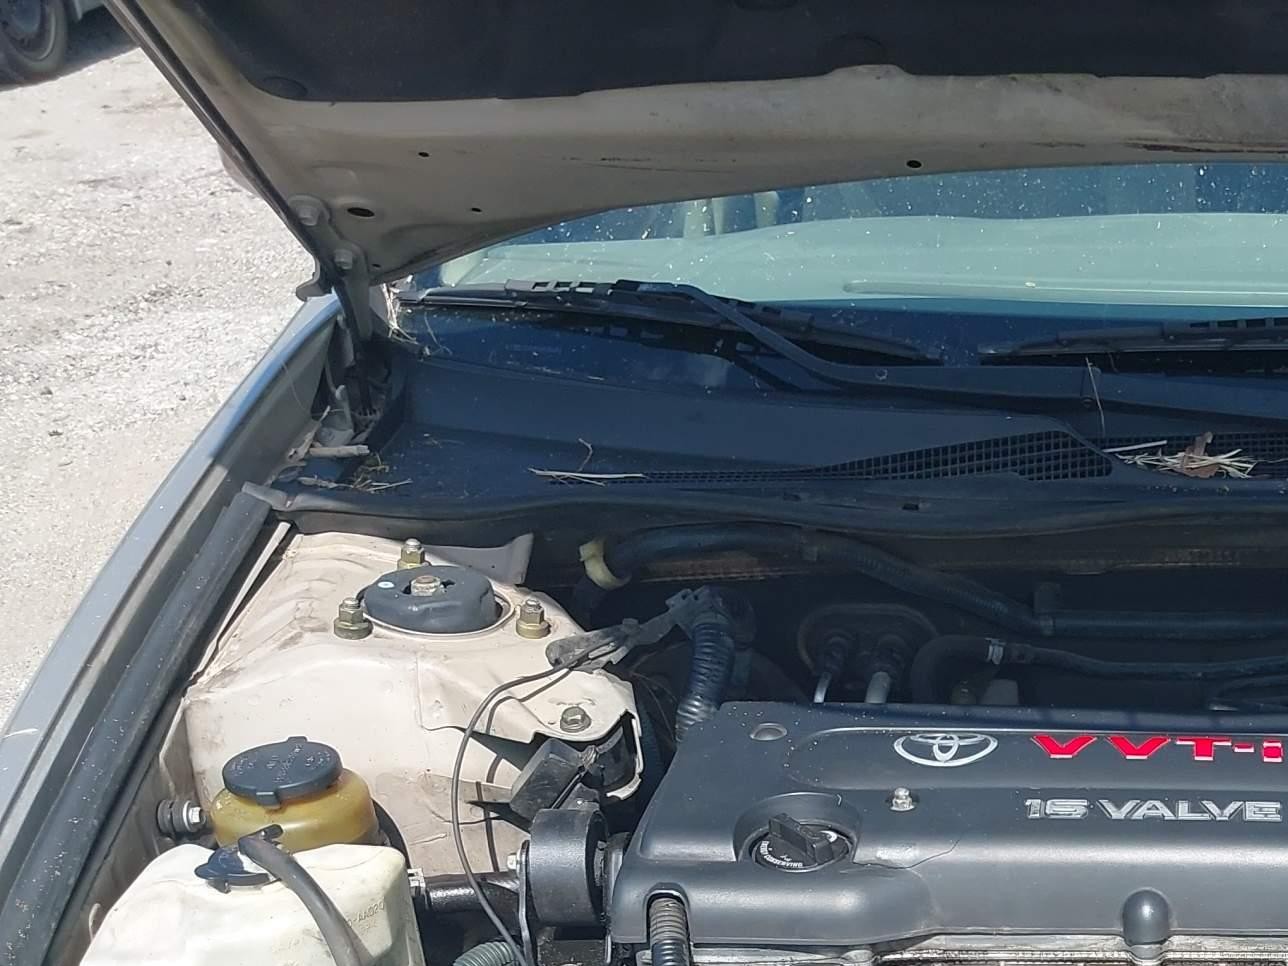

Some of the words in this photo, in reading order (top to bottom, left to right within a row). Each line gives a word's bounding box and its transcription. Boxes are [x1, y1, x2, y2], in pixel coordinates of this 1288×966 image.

[1030, 734, 1285, 763] VVT-i
[1024, 798, 1089, 820] 16
[1096, 798, 1284, 822] VALVE
